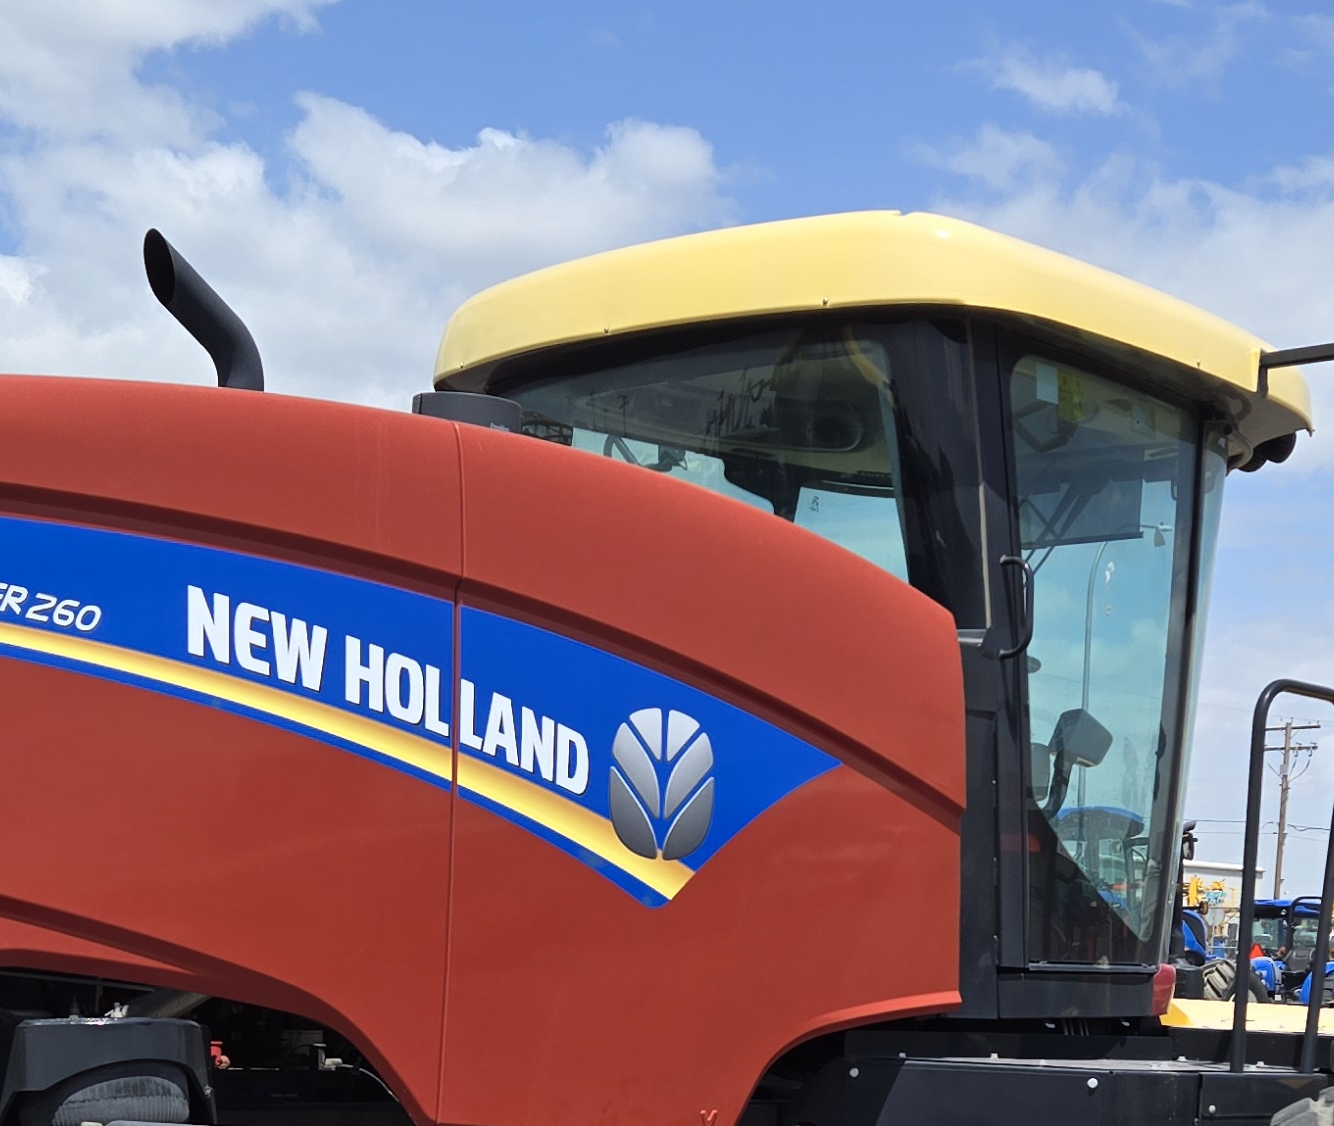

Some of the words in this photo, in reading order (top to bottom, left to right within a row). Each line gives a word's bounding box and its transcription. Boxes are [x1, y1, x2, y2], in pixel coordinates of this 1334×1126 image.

[26, 592, 102, 631] 260
[187, 584, 328, 692] NEW
[345, 634, 589, 796] HOLLAND
